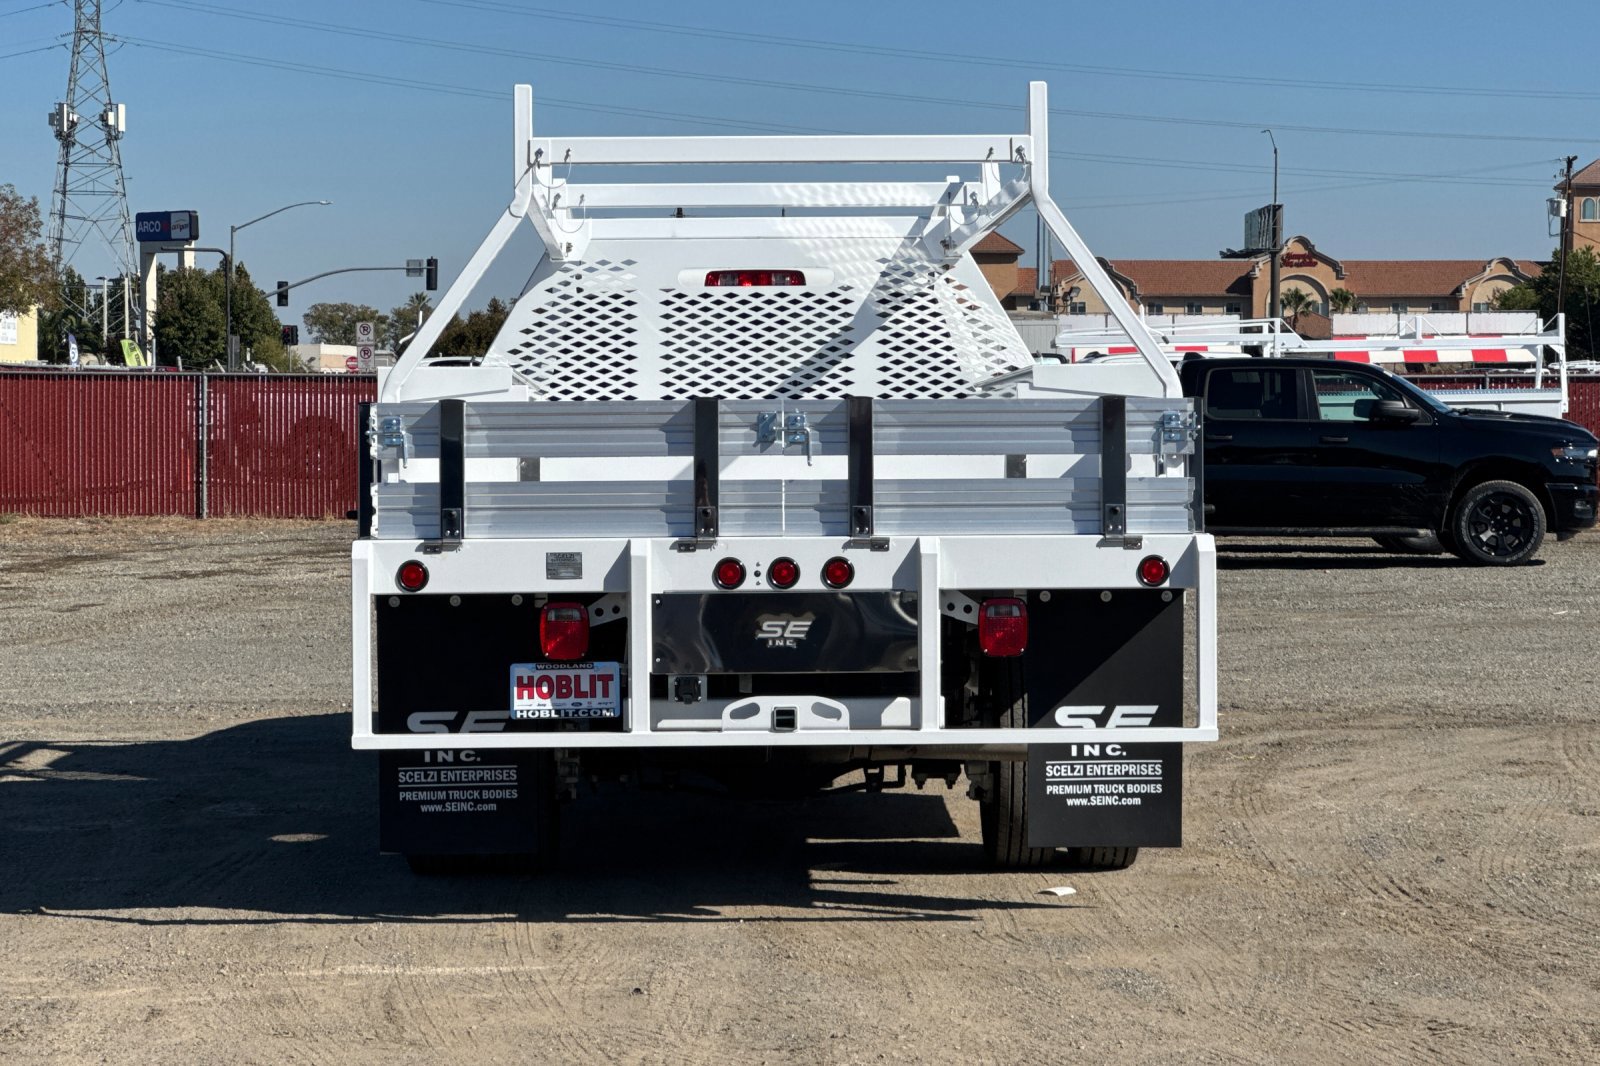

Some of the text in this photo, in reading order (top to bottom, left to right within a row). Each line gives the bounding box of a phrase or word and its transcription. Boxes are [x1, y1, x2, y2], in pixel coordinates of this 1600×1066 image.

[138, 221, 160, 232] ARCO
[758, 621, 812, 637] SE
[516, 674, 614, 700] HOBLIT
[516, 709, 614, 718] HOBLIT.COM
[1071, 744, 1127, 756] INC.
[424, 750, 481, 763] INC.
[398, 769, 517, 783] SCELZI ENTERPRISES
[1046, 763, 1162, 777] SCELZI ENTERPRISES
[399, 789, 518, 801] PREMIUM TRUCK BODIES
[1046, 784, 1163, 795] PREMIUM TRUCK BODIES
[421, 802, 497, 812] www.SEINC.com
[1066, 796, 1141, 806] www.SEINC.com
